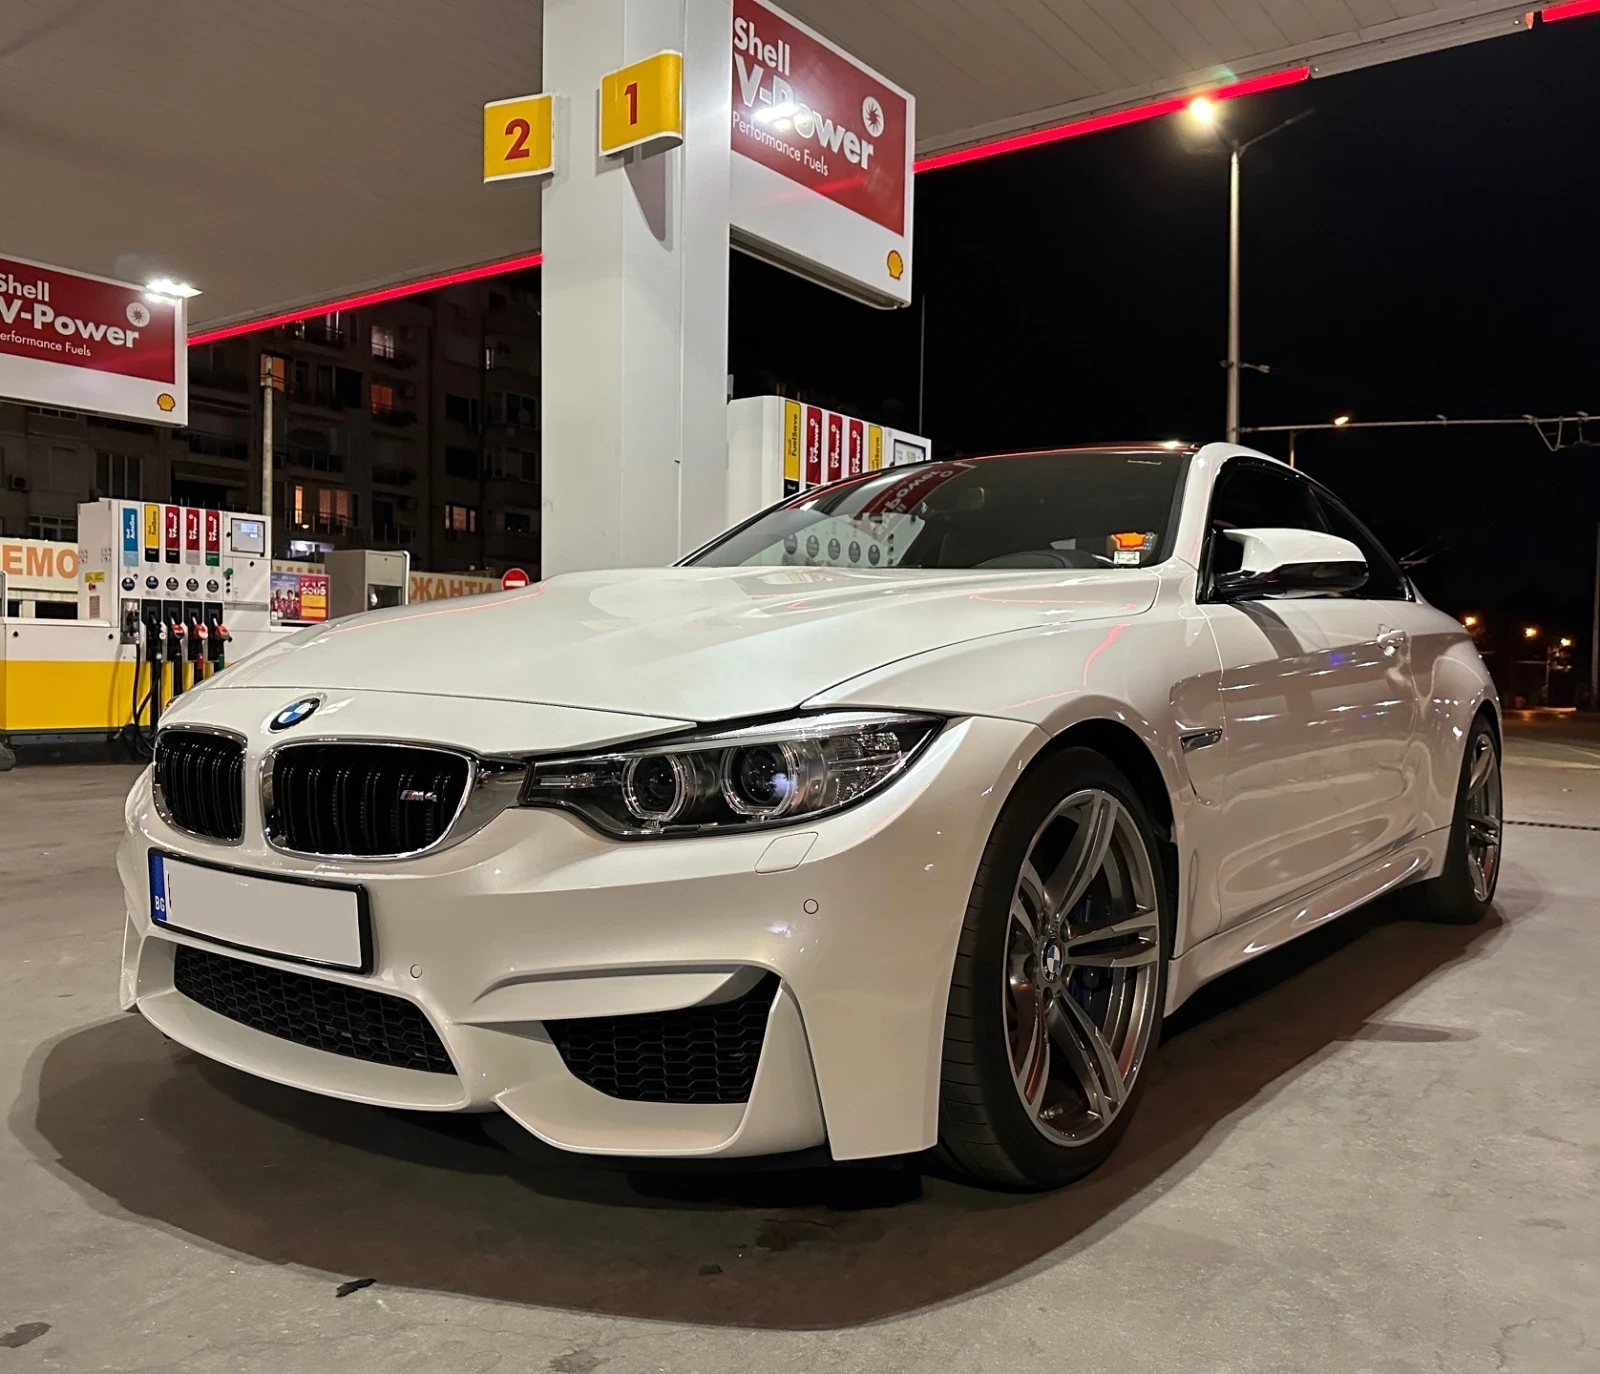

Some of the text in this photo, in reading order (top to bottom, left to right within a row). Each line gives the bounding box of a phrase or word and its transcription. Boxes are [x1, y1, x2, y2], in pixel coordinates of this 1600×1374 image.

[733, 16, 790, 76] Shell
[624, 82, 638, 125] 1
[734, 53, 874, 169] V-Power
[504, 118, 530, 161] 2
[733, 111, 828, 176] Performance Fuels
[0, 273, 49, 302] Shell
[0, 295, 140, 349] V-Power
[0, 330, 91, 357] erformance Fuels
[410, 790, 438, 803] M4
[154, 895, 165, 912] BG
